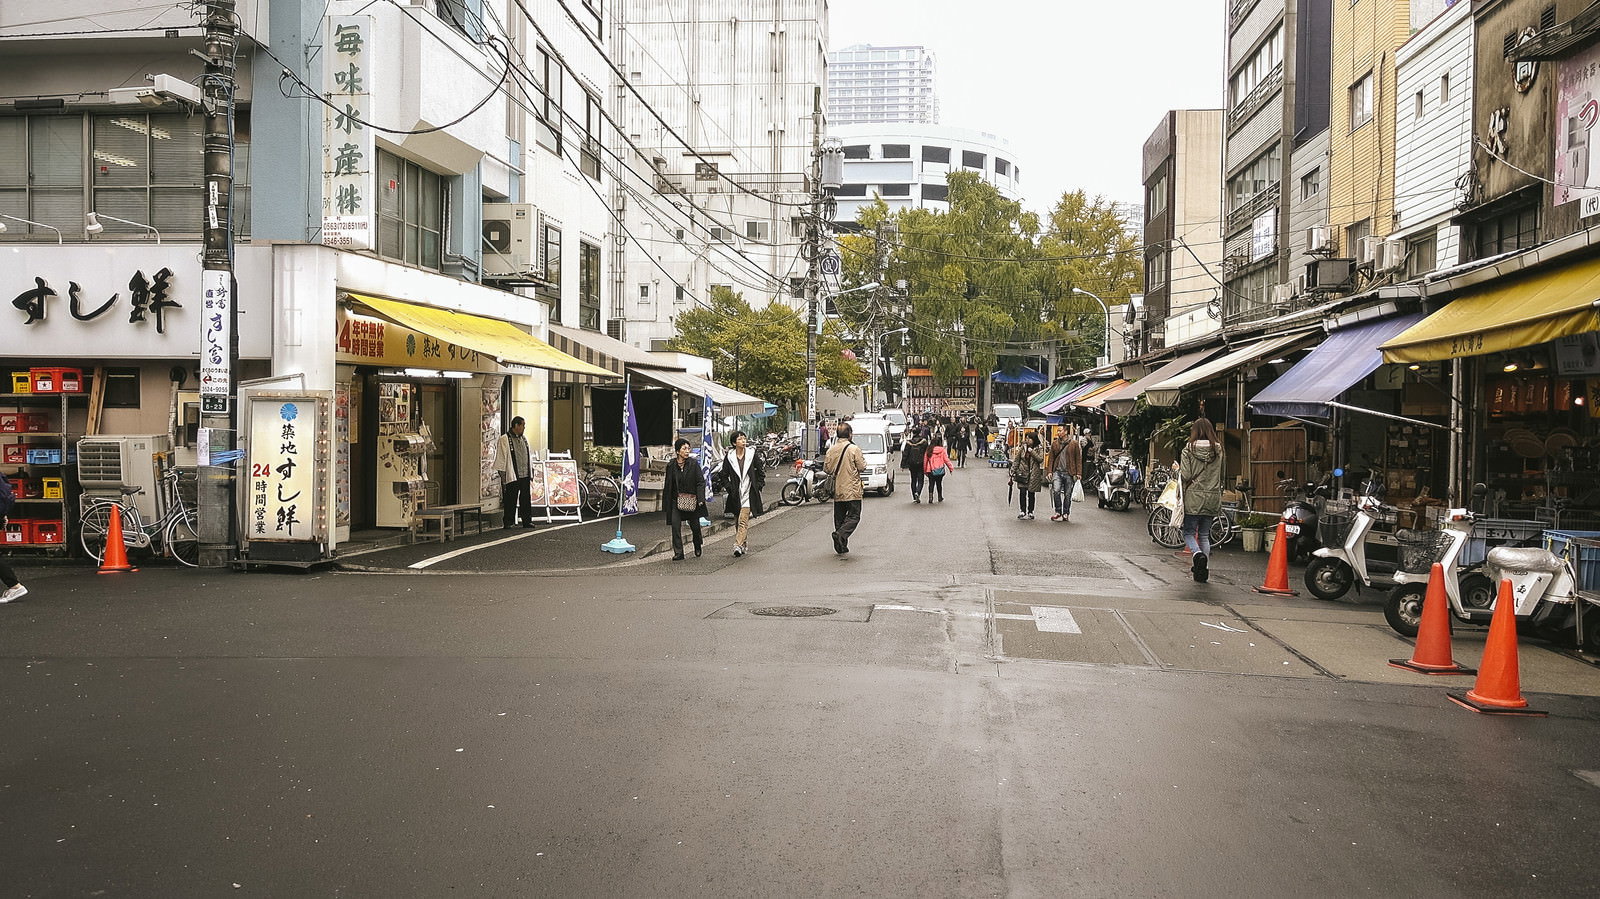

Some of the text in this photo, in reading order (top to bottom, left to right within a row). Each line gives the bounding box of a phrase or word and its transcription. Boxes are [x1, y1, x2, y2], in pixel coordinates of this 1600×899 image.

[12, 267, 183, 334] すし鮮
[352, 319, 385, 340] 年中無休
[352, 338, 385, 358] 時間営業
[423, 336, 441, 358] 築地
